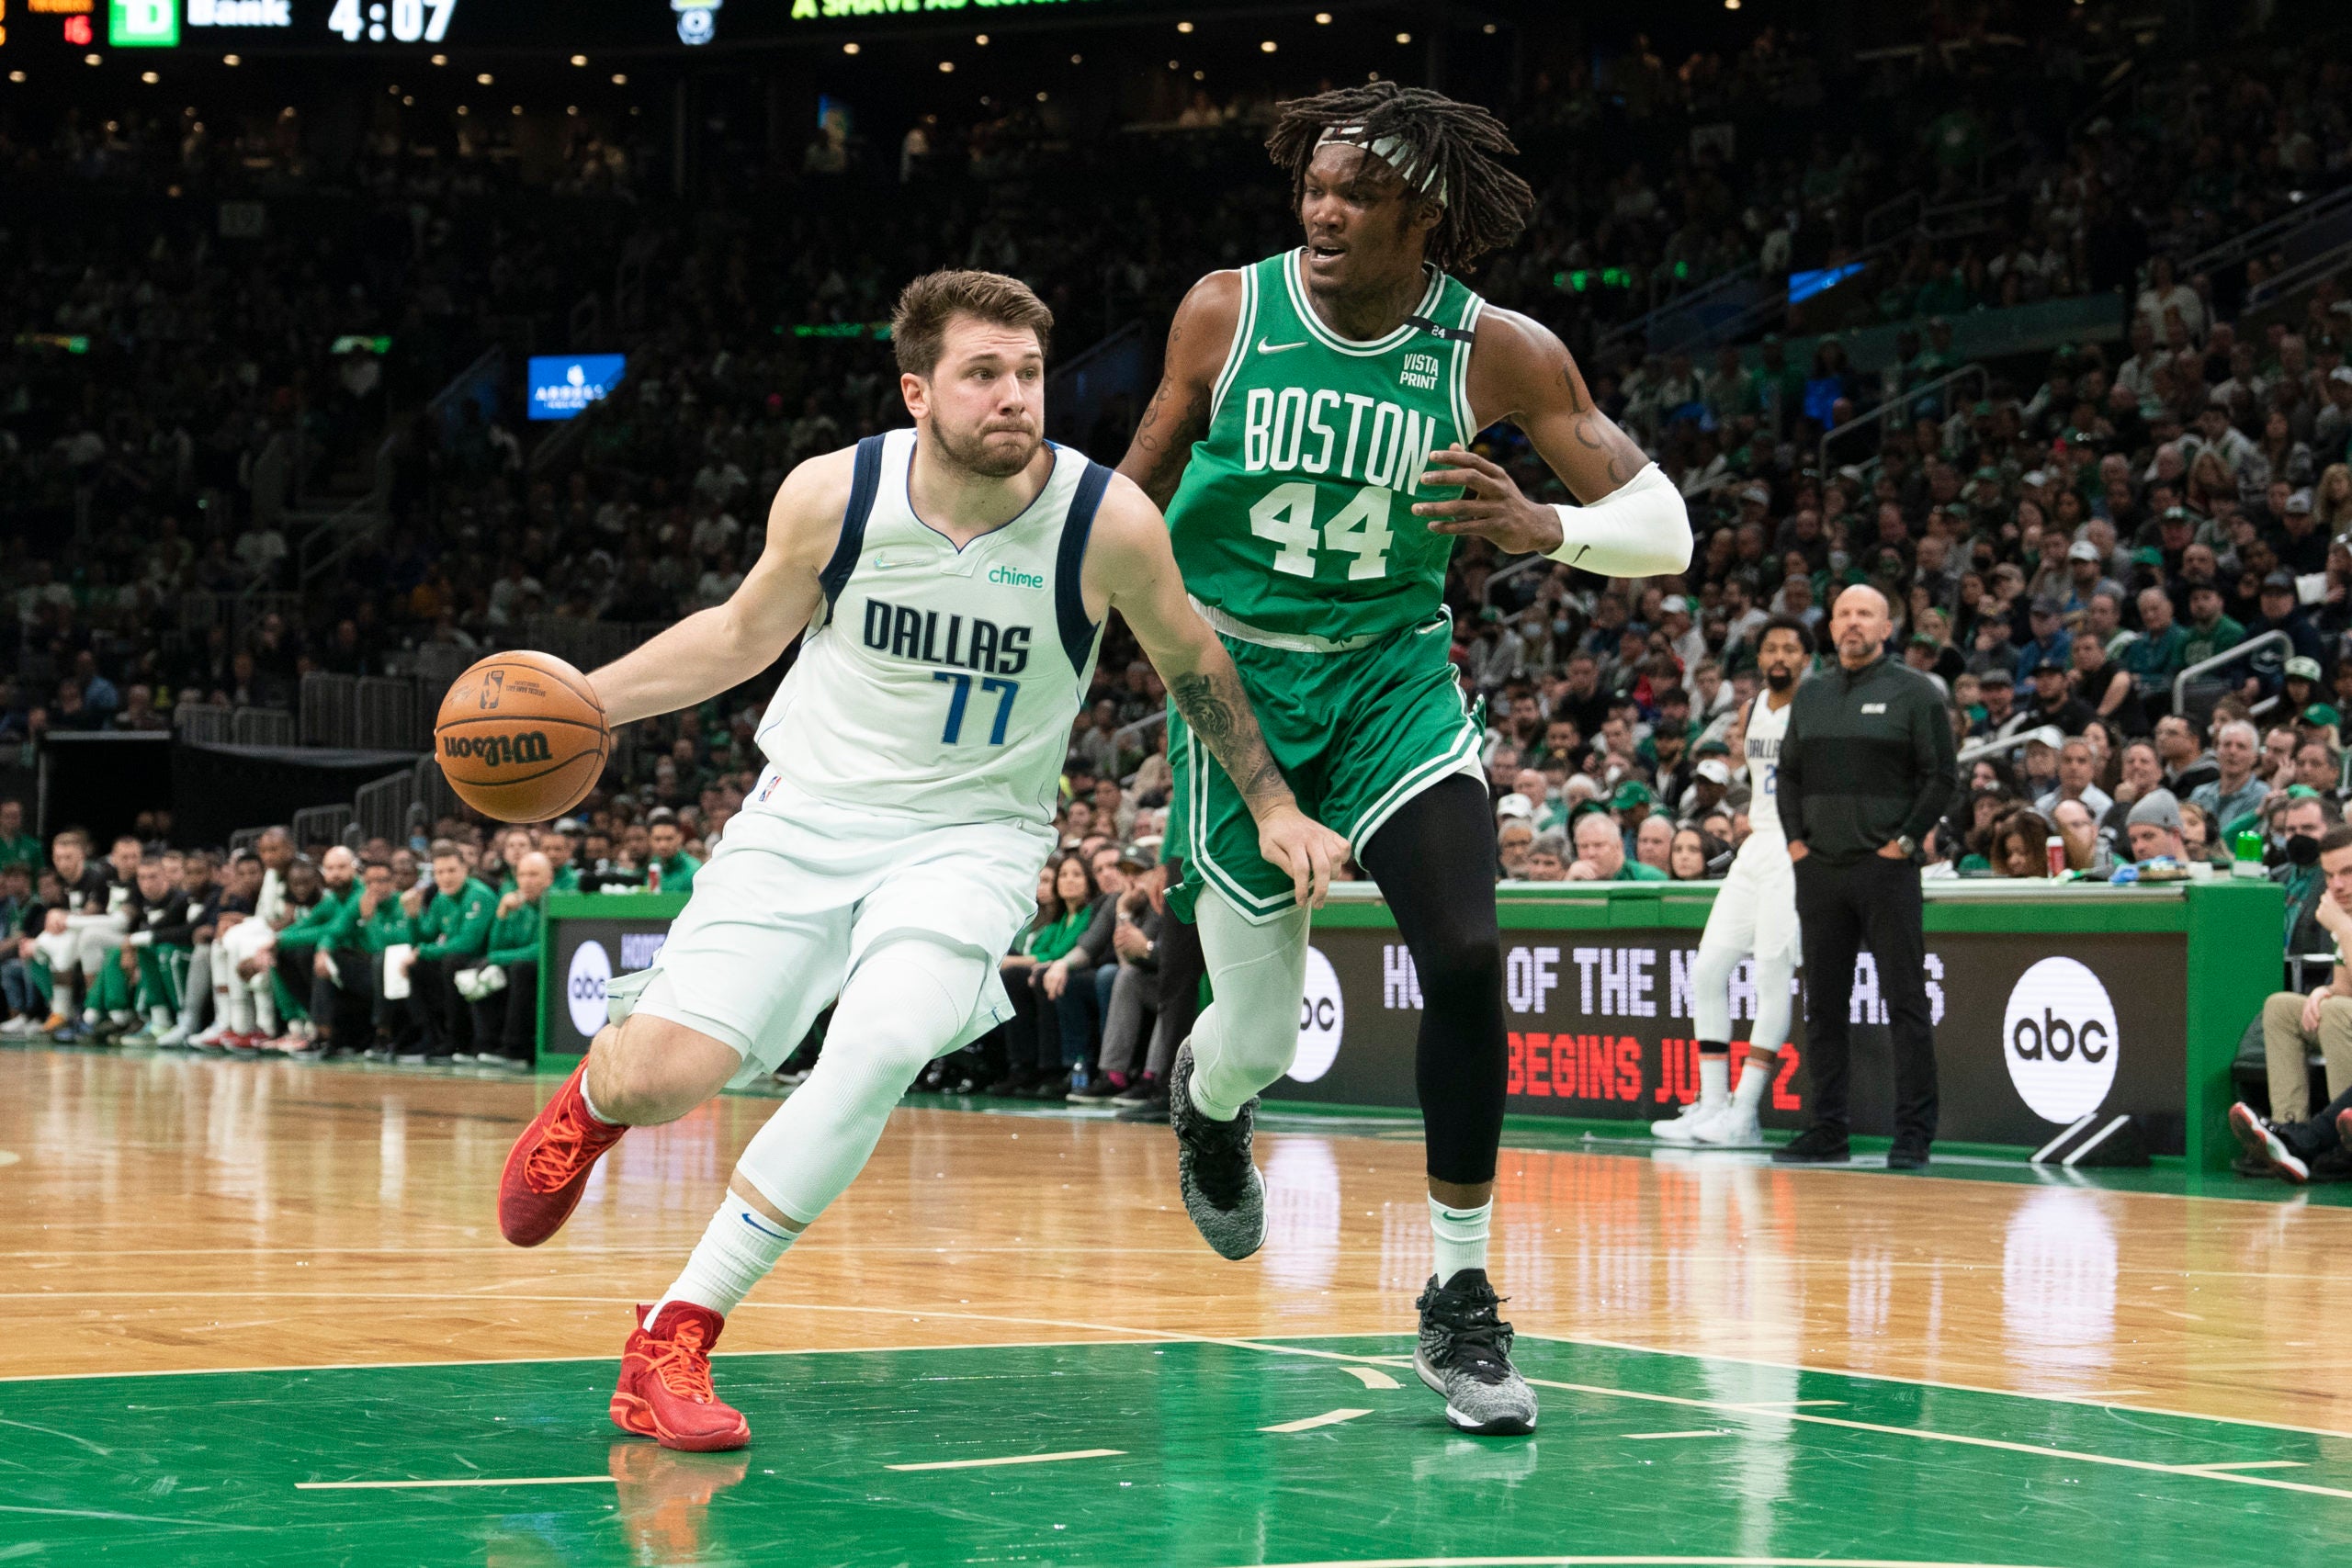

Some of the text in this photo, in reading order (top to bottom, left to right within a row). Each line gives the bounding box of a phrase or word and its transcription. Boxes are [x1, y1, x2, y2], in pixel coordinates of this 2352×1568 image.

[328, 0, 456, 41] 4:07
[1431, 325, 1446, 338] 24
[1399, 371, 1438, 390] PRINT
[1404, 354, 1439, 377] VISTA
[1245, 388, 1435, 495] BOSTON
[1250, 482, 1394, 580] 44
[989, 566, 1044, 589] chime
[864, 597, 1033, 675] DALLAS
[932, 671, 1021, 746] 77
[444, 730, 553, 767] Wilson
[1507, 946, 1560, 1013] OF
[1573, 947, 1657, 1017] THE
[1670, 950, 1757, 1020] NA
[2014, 1008, 2108, 1063] abc
[1507, 1032, 1642, 1101] BEGINS
[1772, 1043, 1801, 1110] 2
